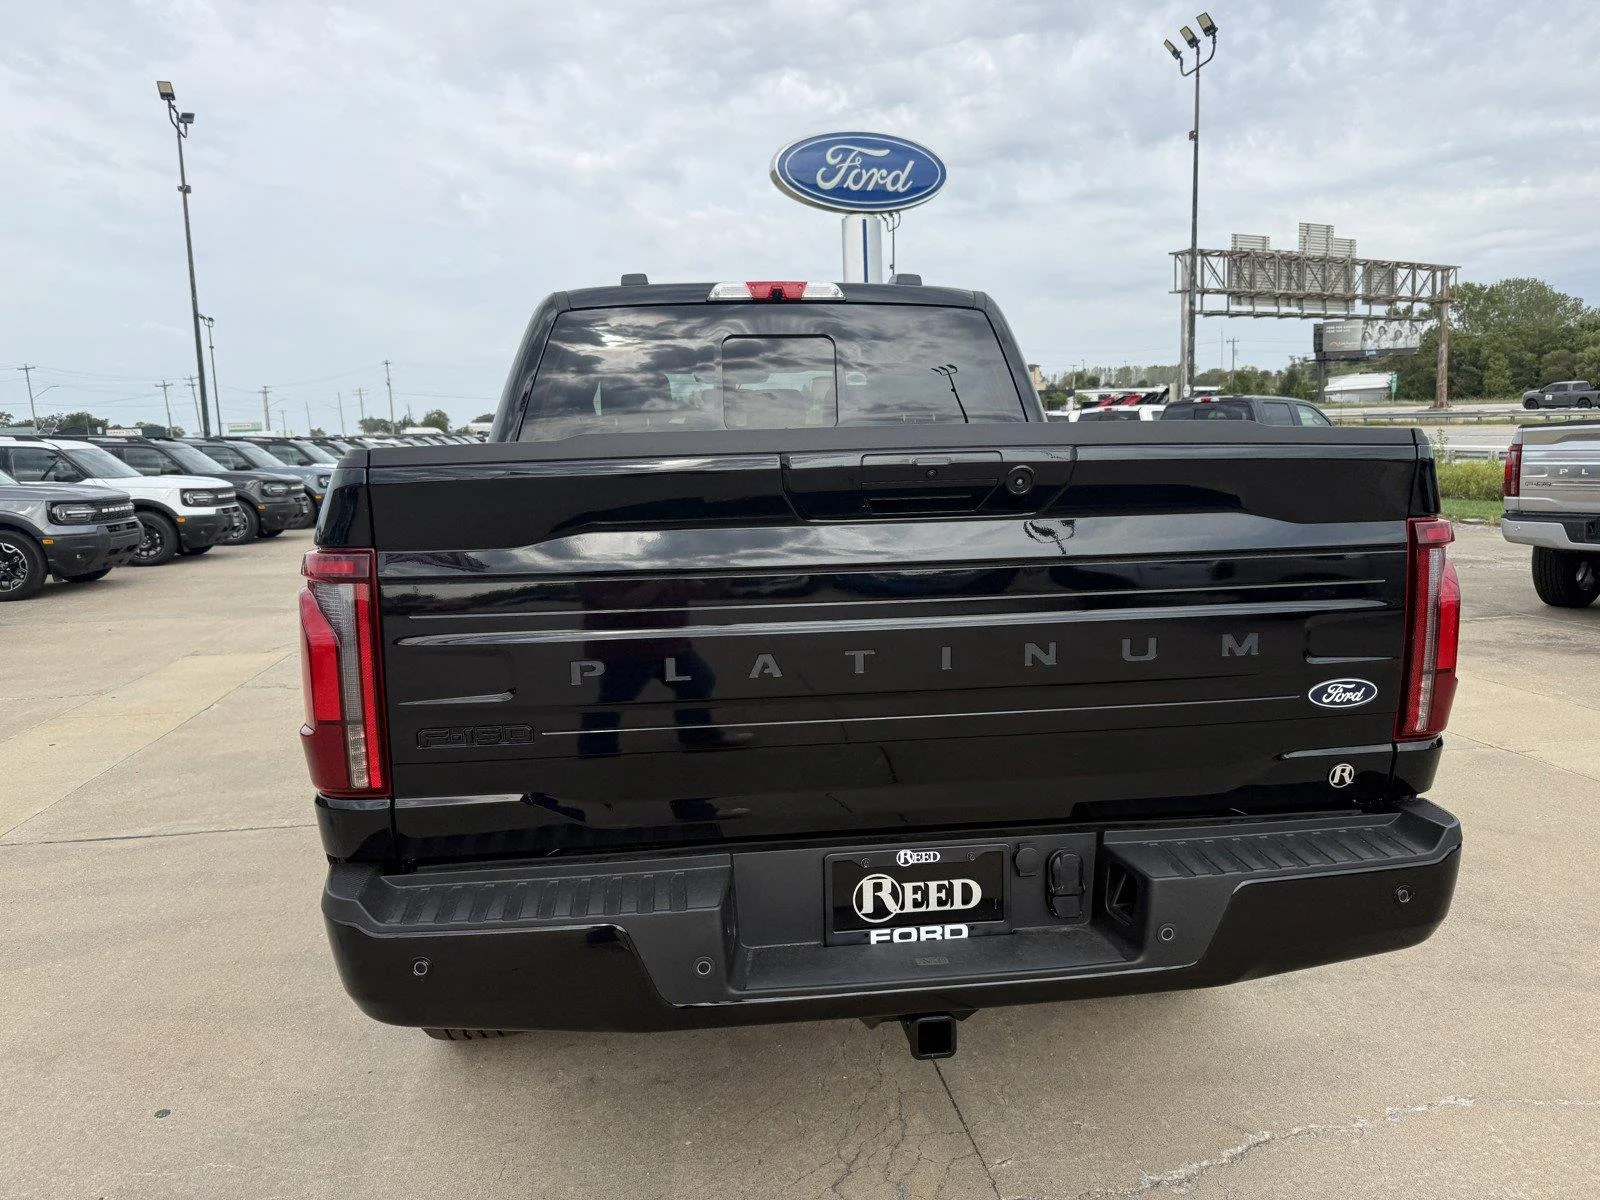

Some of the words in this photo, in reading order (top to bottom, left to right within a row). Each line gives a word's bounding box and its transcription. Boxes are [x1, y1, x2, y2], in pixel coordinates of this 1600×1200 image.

[816, 144, 915, 193] Ford
[569, 632, 1260, 686] PLATINUM
[1322, 683, 1366, 703] Ford
[417, 725, 535, 749] F-150
[1331, 765, 1354, 785] R
[898, 850, 940, 865] REED
[857, 876, 982, 916] REED
[870, 923, 969, 945] FORD
